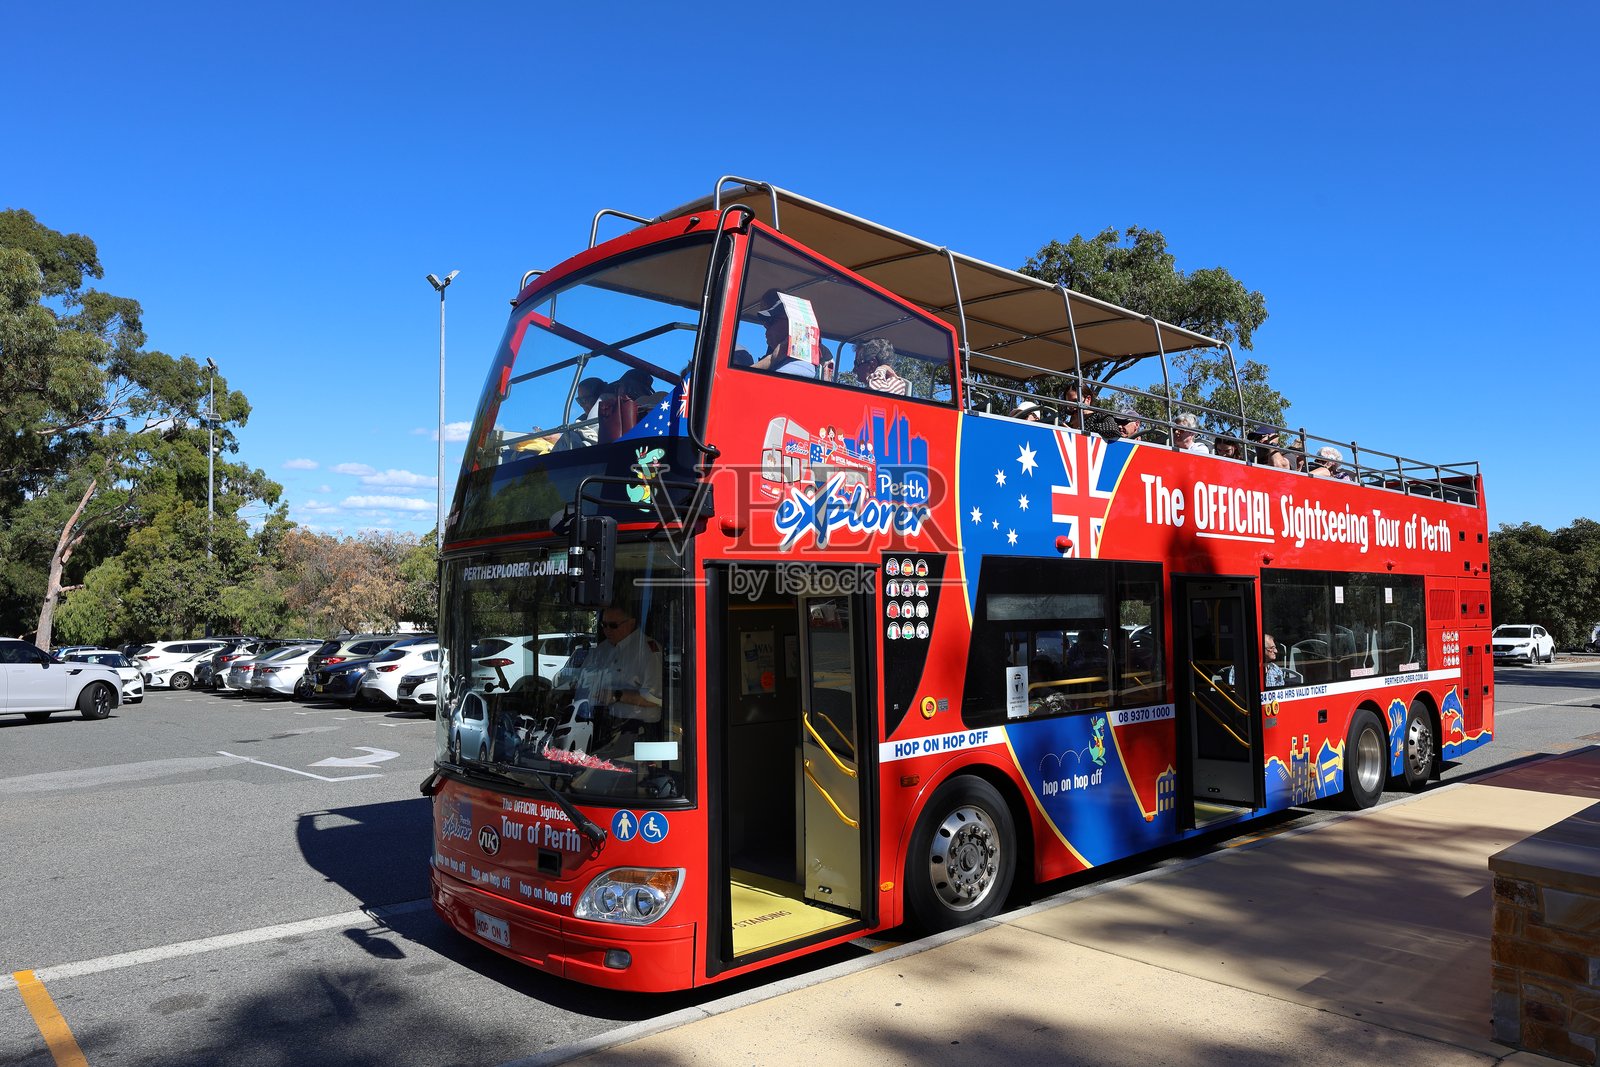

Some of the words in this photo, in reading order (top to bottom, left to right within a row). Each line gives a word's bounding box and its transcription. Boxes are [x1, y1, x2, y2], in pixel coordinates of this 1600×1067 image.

[878, 474, 926, 500] Perth
[1141, 473, 1185, 527] The
[1194, 481, 1274, 537] OFFICIAL
[1281, 495, 1369, 553] Sightseeing
[1373, 509, 1400, 548] Tour
[1404, 513, 1417, 549] of
[1421, 516, 1451, 553] Perth
[463, 560, 568, 581] PERTHEXPLORER.COM.A
[1268, 691, 1276, 701] OR
[1284, 689, 1296, 699] HRS
[1296, 687, 1310, 697] VALID
[1311, 685, 1327, 696] TICKET
[1118, 712, 1129, 723] 08
[1130, 709, 1150, 721] 9370
[1152, 706, 1170, 718] 1000
[895, 741, 920, 758] HOP
[923, 738, 940, 753] ON
[943, 734, 966, 750] HOP
[968, 730, 989, 746] OFF
[1042, 780, 1059, 797] hop
[1061, 780, 1071, 792] on
[1074, 773, 1089, 790] hop
[1091, 768, 1103, 785] off
[502, 798, 513, 812] The
[514, 800, 538, 816] OFFICIAL
[502, 815, 523, 841] Tour
[527, 821, 541, 845] of
[544, 824, 581, 853] Perth
[471, 866, 481, 881] hop
[481, 871, 489, 882] on
[490, 871, 500, 889] hop
[501, 876, 511, 890] off
[520, 881, 532, 897] hop
[533, 887, 542, 899] on
[544, 887, 558, 905] hop
[560, 892, 572, 907] off
[476, 920, 489, 935] HOP
[491, 926, 501, 938] ON
[503, 930, 509, 942] 3
[733, 910, 792, 928] STANDING
